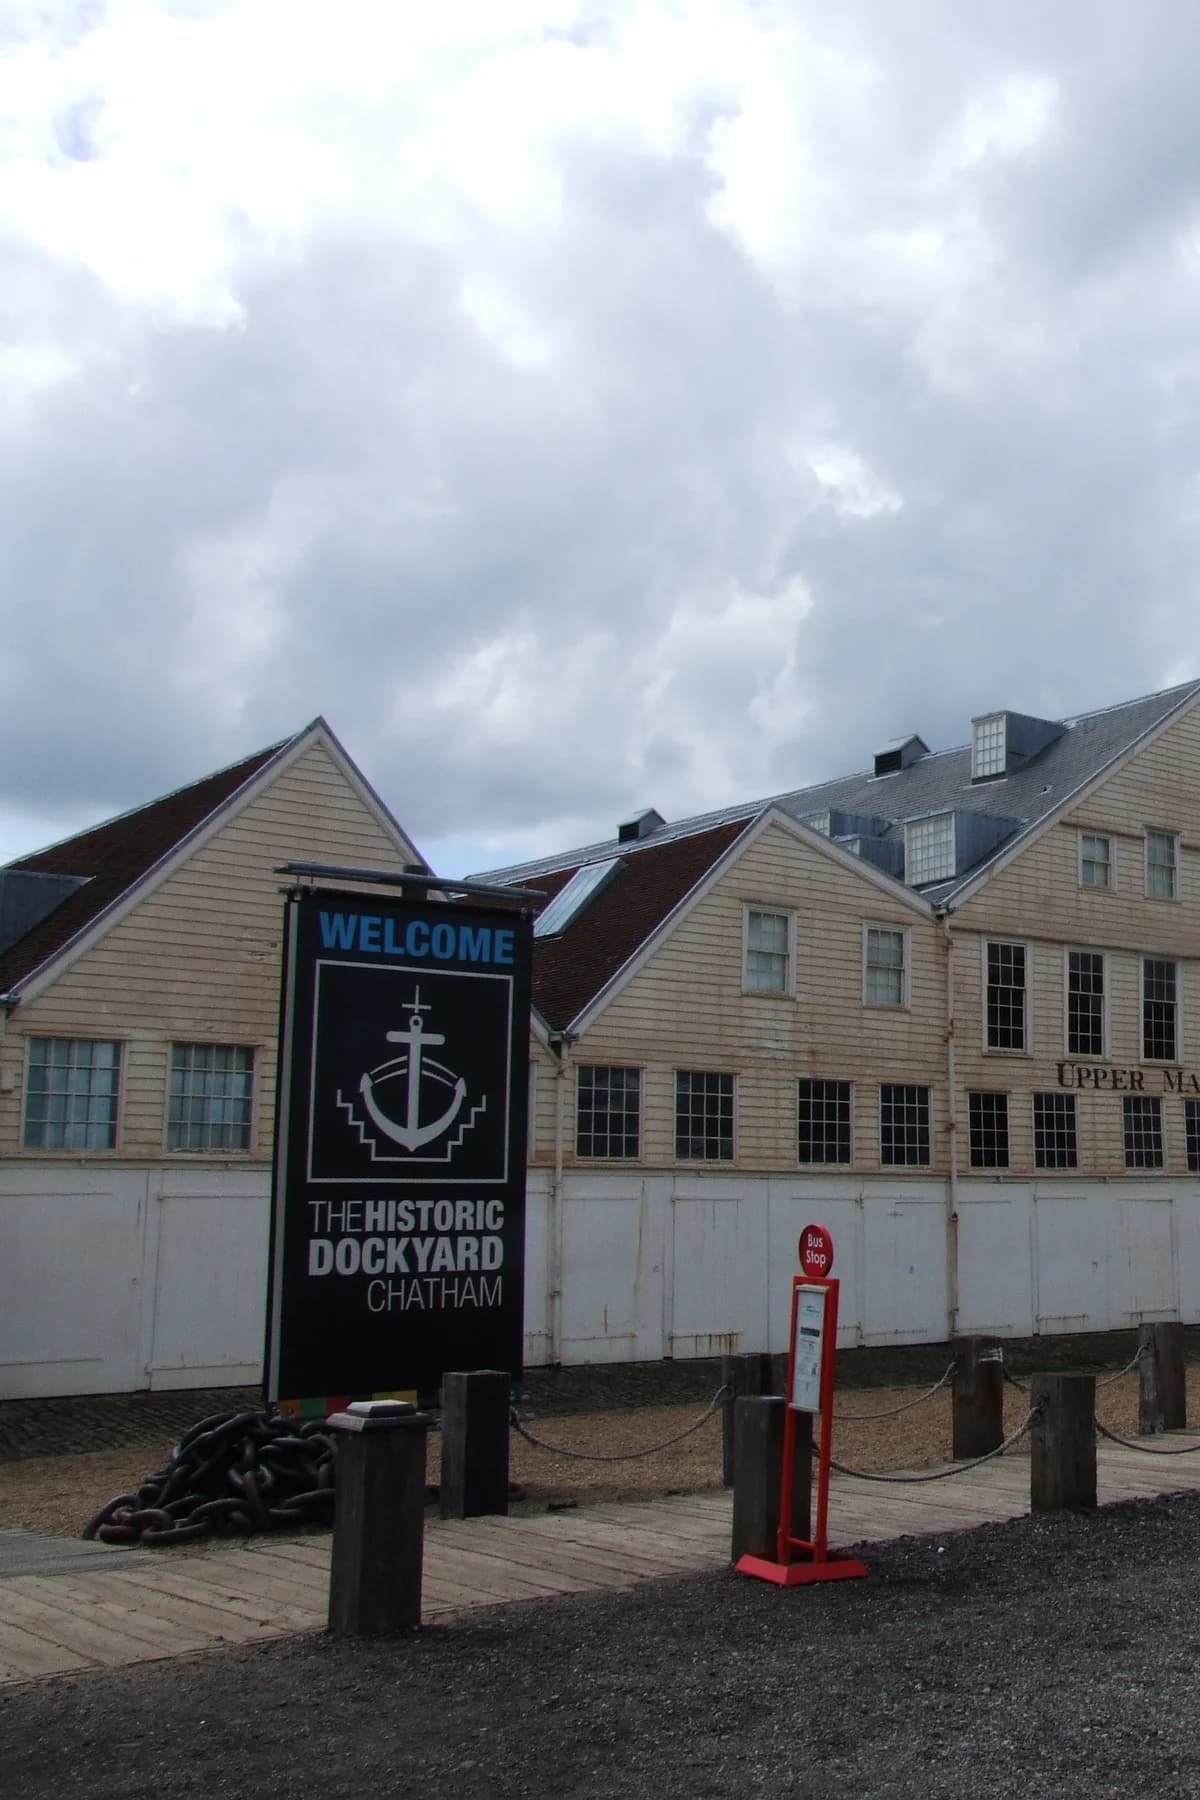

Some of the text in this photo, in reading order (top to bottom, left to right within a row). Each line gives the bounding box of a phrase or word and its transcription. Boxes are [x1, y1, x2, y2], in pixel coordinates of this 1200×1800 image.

[319, 911, 514, 965] WELCOME
[1056, 1063, 1144, 1091] UPPER
[308, 1200, 504, 1232] THE HISTORIC
[308, 1235, 504, 1276] DOCKYARD
[807, 1233, 824, 1248] Bus
[806, 1250, 826, 1268] Stop
[367, 1276, 503, 1312] CHATHAM
